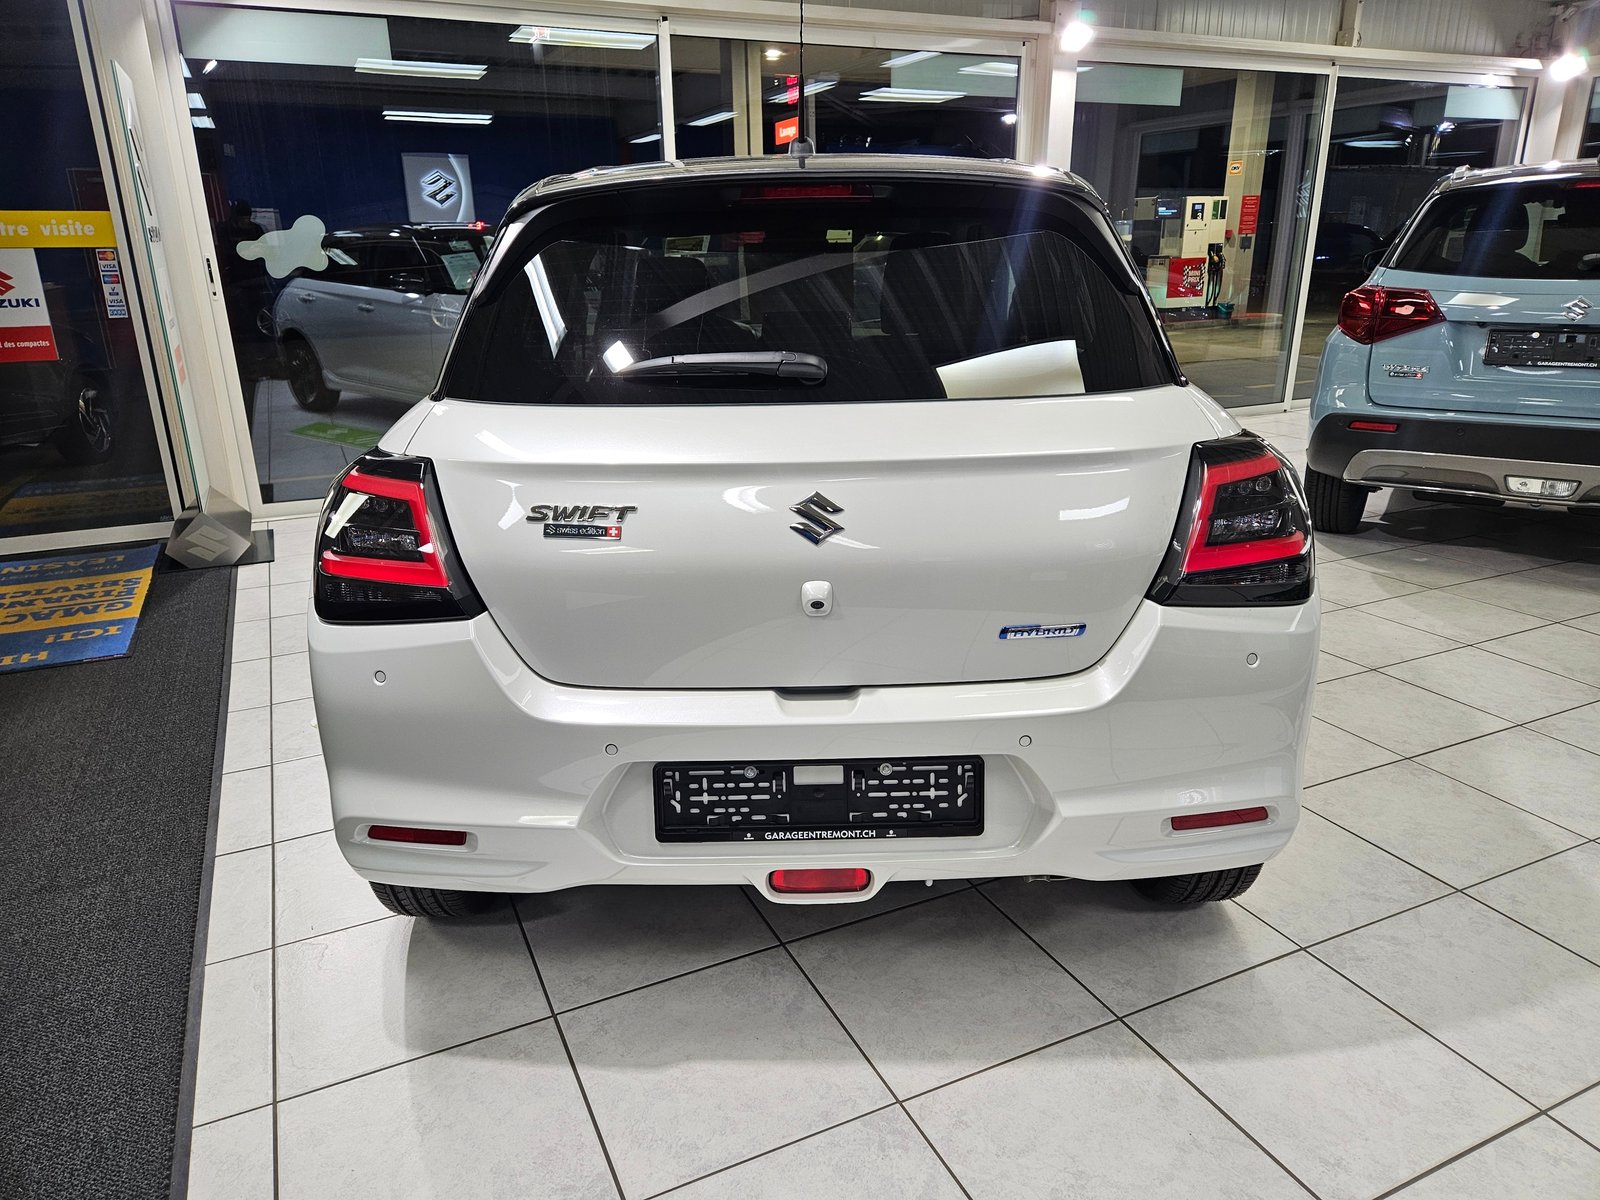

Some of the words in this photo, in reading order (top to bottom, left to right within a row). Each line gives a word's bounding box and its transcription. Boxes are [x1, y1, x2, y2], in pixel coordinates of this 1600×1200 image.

[40, 219, 95, 236] visite
[16, 340, 50, 348] compactes
[525, 504, 639, 523] SWIFT
[556, 527, 579, 535] swiss
[579, 527, 606, 535] edition
[0, 600, 133, 625] GMAC
[44, 625, 123, 644] ICI!
[764, 829, 876, 840] GARAGEENTREMONT.CH
